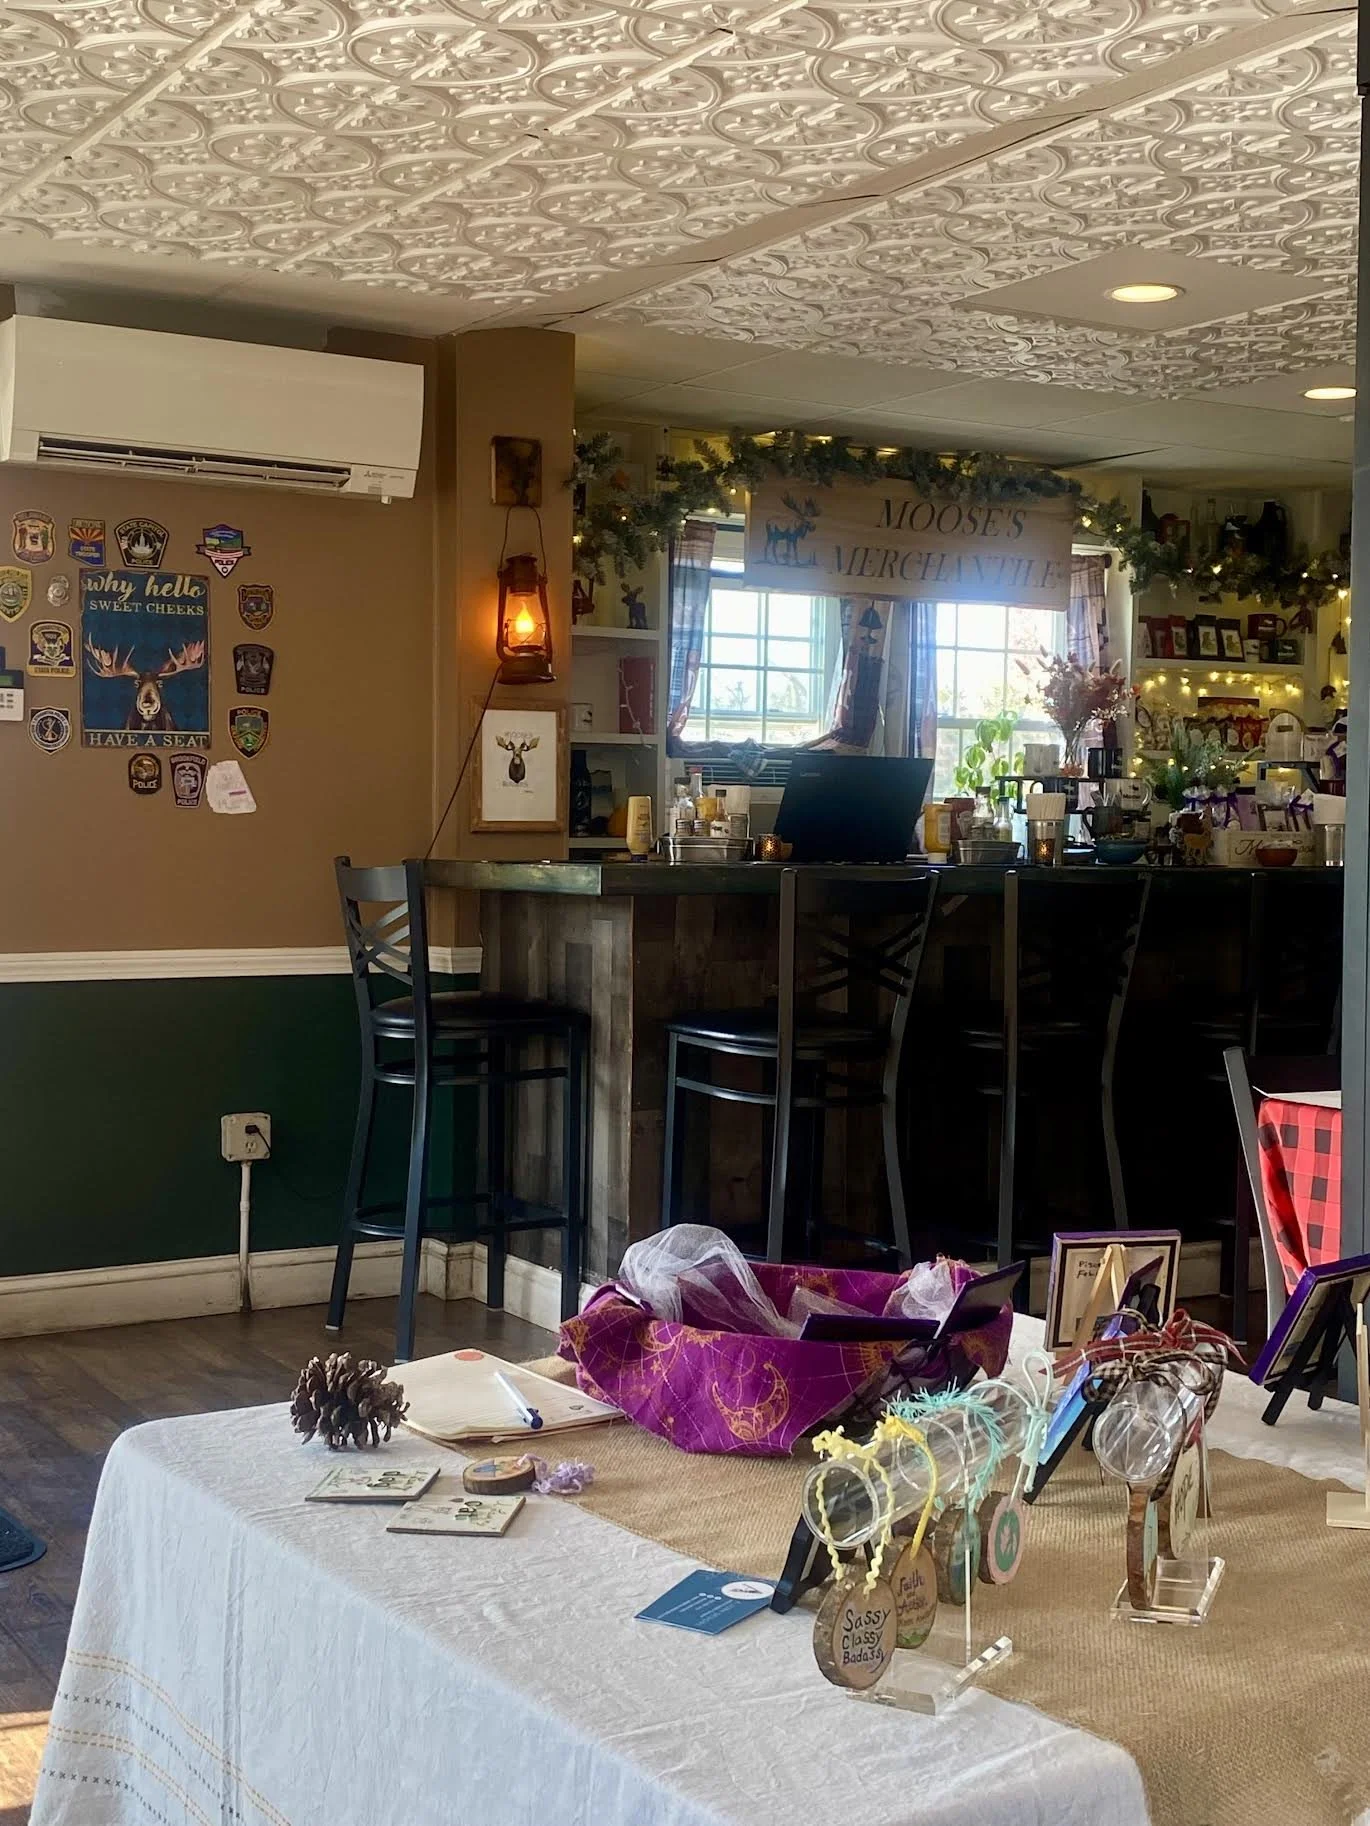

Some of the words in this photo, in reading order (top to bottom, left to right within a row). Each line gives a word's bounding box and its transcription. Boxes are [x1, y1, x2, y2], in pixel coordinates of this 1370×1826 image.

[876, 498, 1027, 540] MOOSE'S
[827, 545, 1061, 589] MERCHANTILE
[87, 571, 136, 602] why
[144, 574, 206, 598] hello
[89, 599, 142, 613] SWEET
[146, 602, 204, 616] CHEEKS
[89, 732, 138, 746] HAVE
[144, 734, 157, 746] A
[163, 735, 208, 748] SEAT
[132, 778, 158, 789] POLICE
[842, 1608, 892, 1632] Sassy
[842, 1630, 884, 1649] Classy
